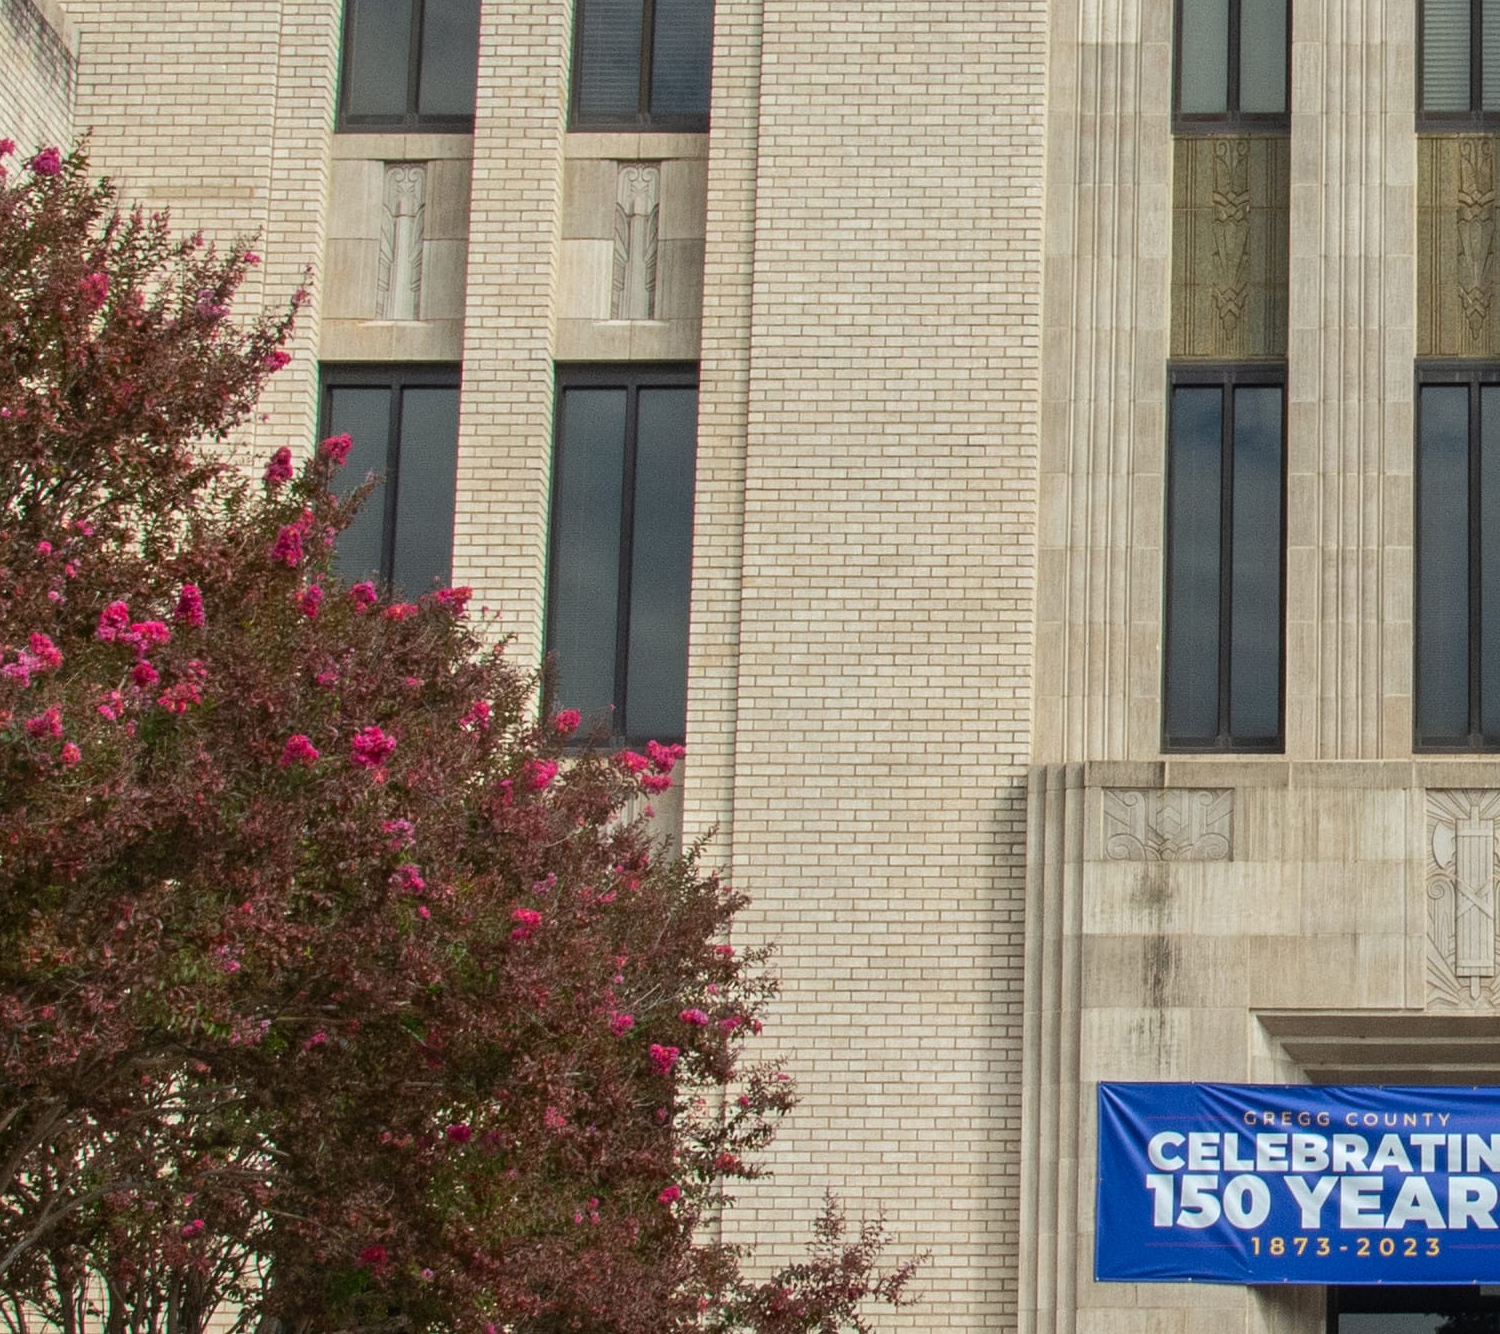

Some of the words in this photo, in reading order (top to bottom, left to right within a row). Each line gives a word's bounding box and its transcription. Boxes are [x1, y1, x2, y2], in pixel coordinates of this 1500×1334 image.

[1244, 1111, 1330, 1127] GREGG
[1346, 1112, 1452, 1127] COUNTY
[1145, 1174, 1271, 1229] 150
[1251, 1237, 1442, 1257] 1873-2023
